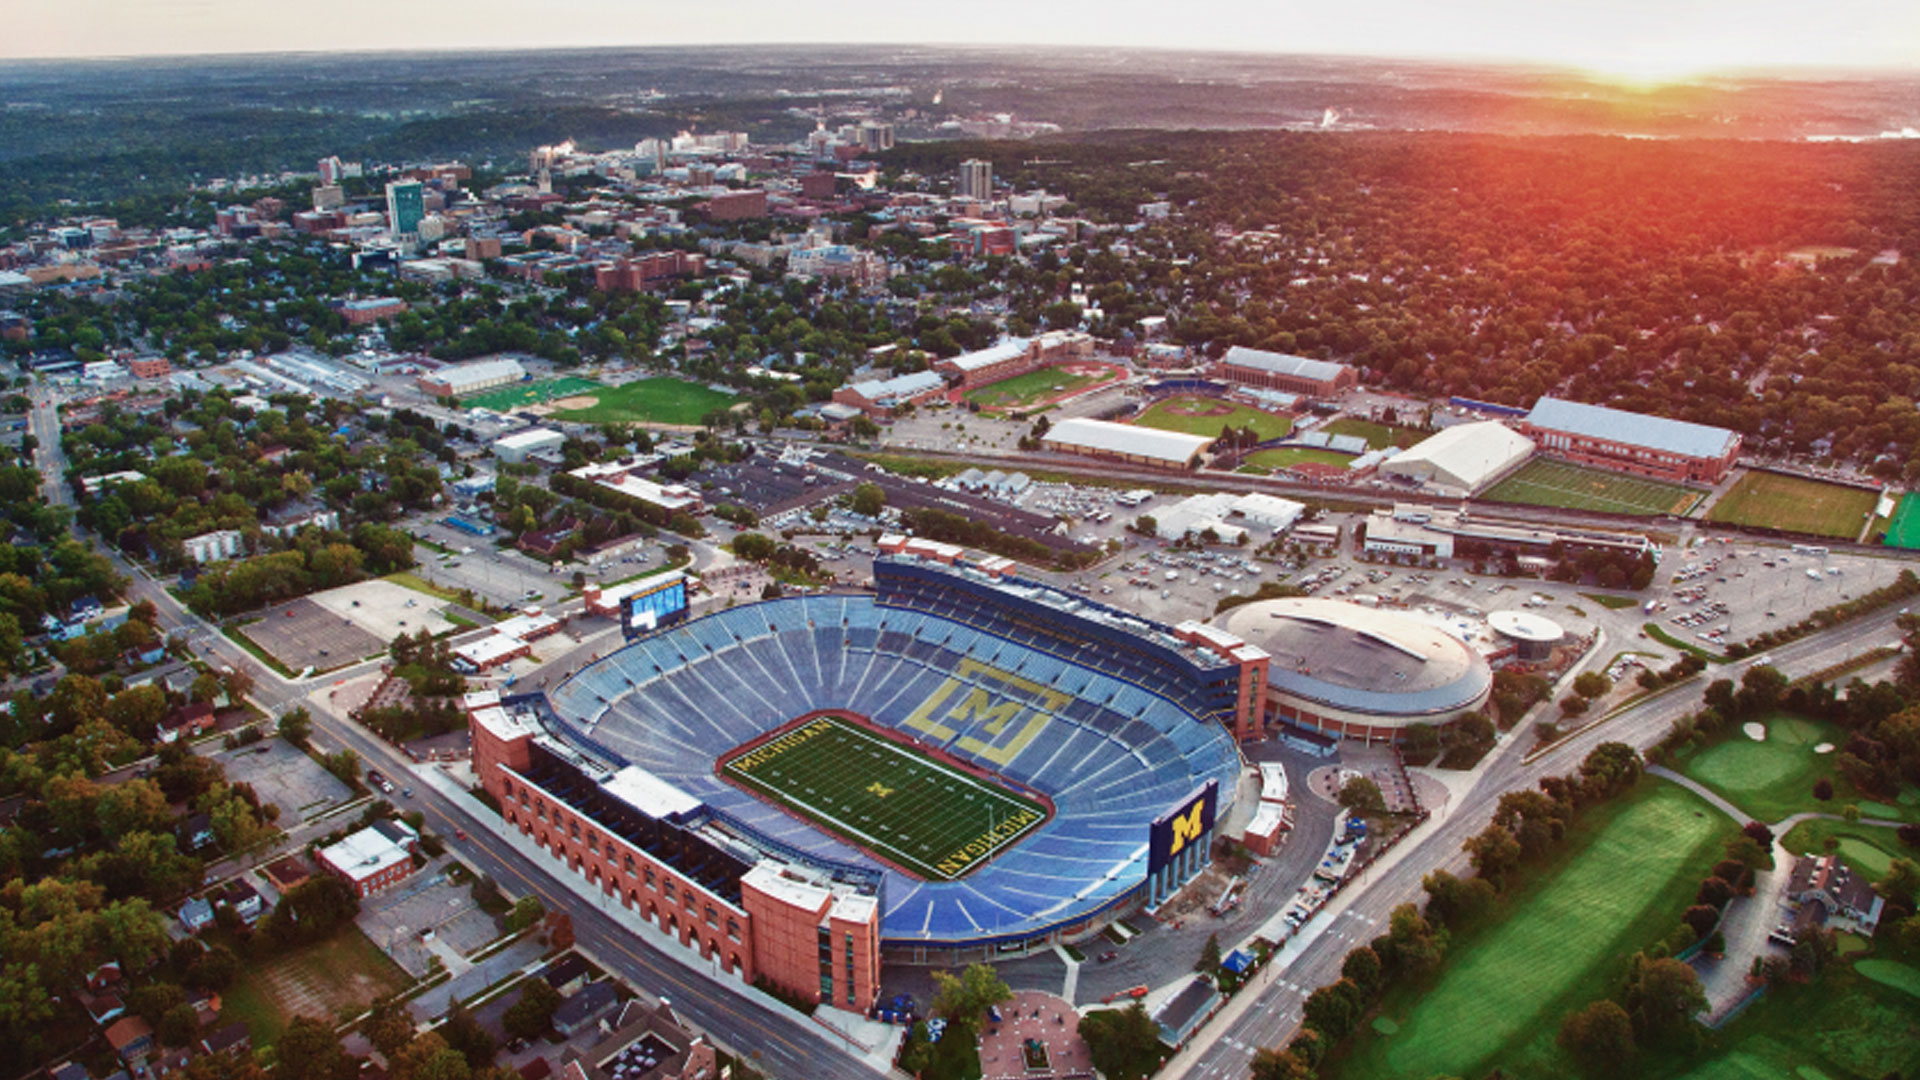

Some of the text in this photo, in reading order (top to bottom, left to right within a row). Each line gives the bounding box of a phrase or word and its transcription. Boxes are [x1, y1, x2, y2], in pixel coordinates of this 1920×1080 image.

[734, 720, 832, 771] MICHIGAN
[937, 810, 1036, 874] MICHIGAN
[1170, 798, 1205, 856] M
